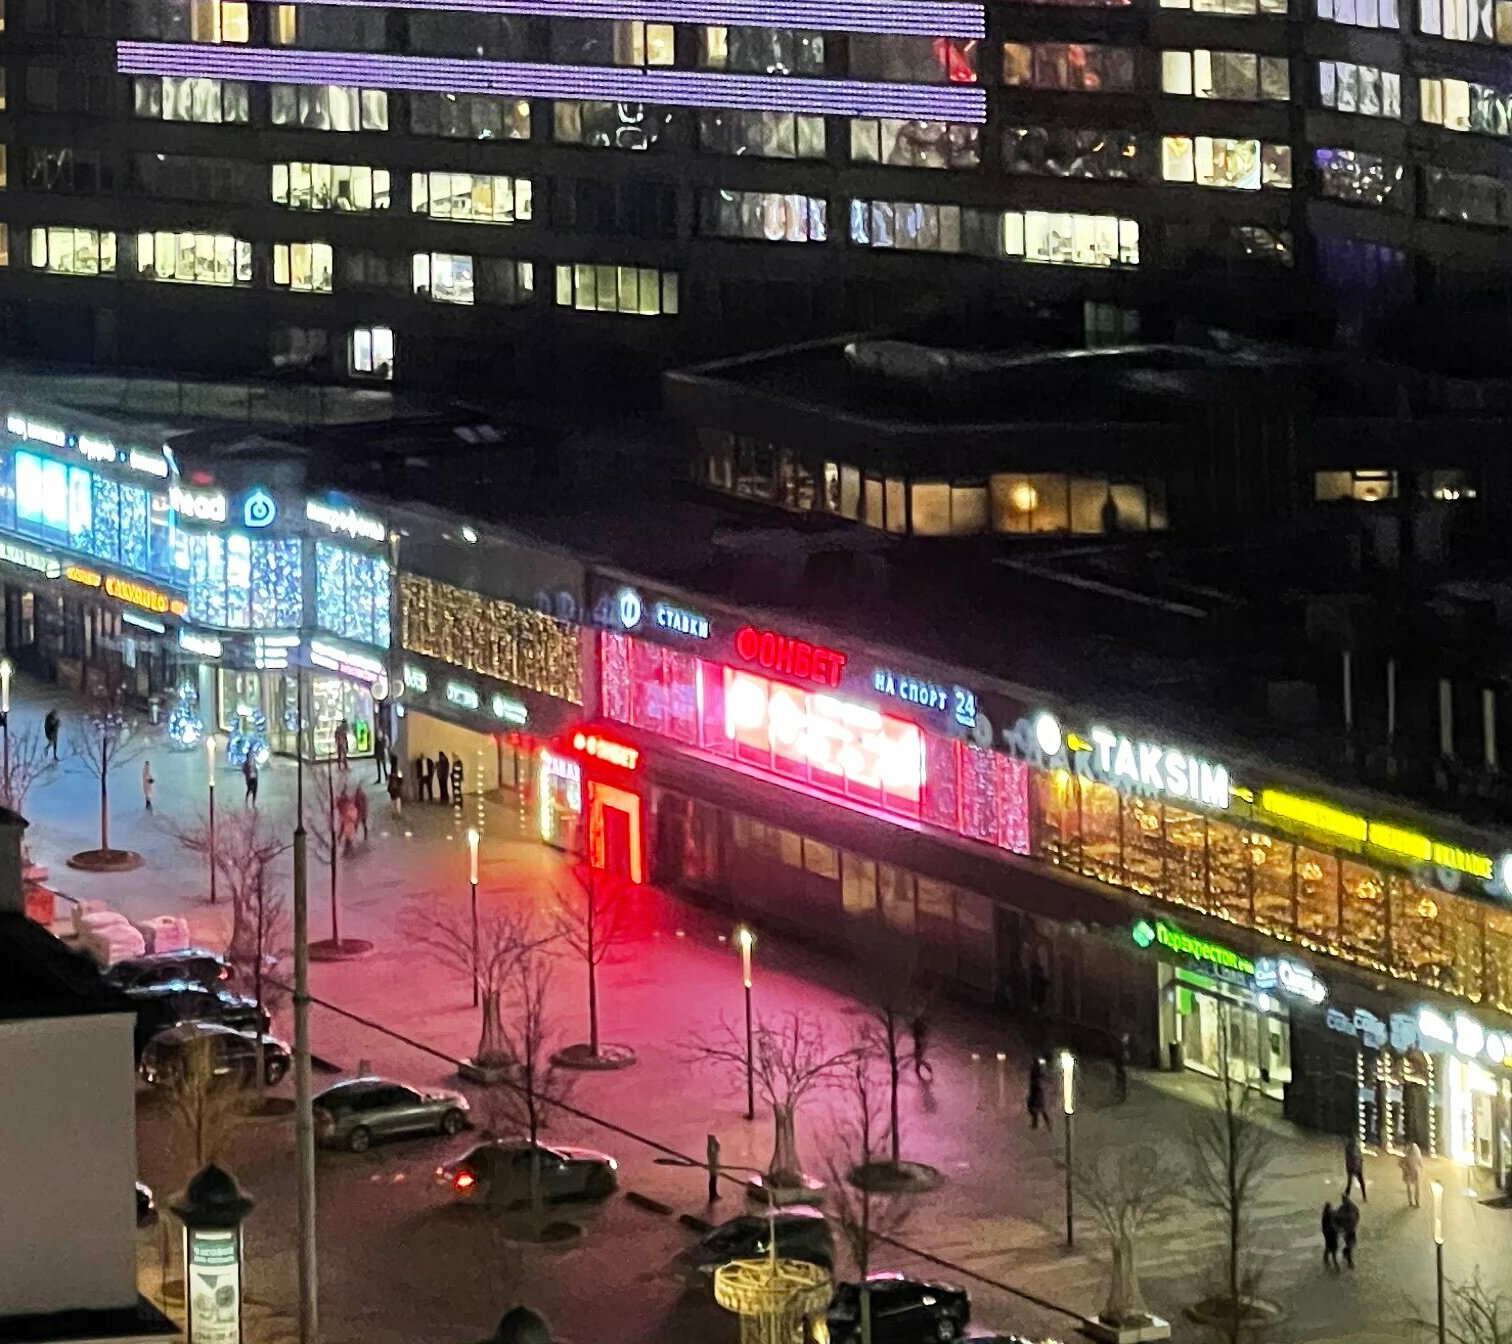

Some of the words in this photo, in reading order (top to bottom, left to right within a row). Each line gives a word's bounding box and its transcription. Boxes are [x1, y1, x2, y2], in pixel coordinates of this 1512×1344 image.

[656, 605, 710, 639] СТАВКИ
[874, 672, 895, 696] НА
[899, 681, 948, 710] СПОРТ
[955, 691, 976, 718] 24
[734, 625, 847, 688] ФОНБЕТ
[1092, 726, 1230, 809] TAKSIM
